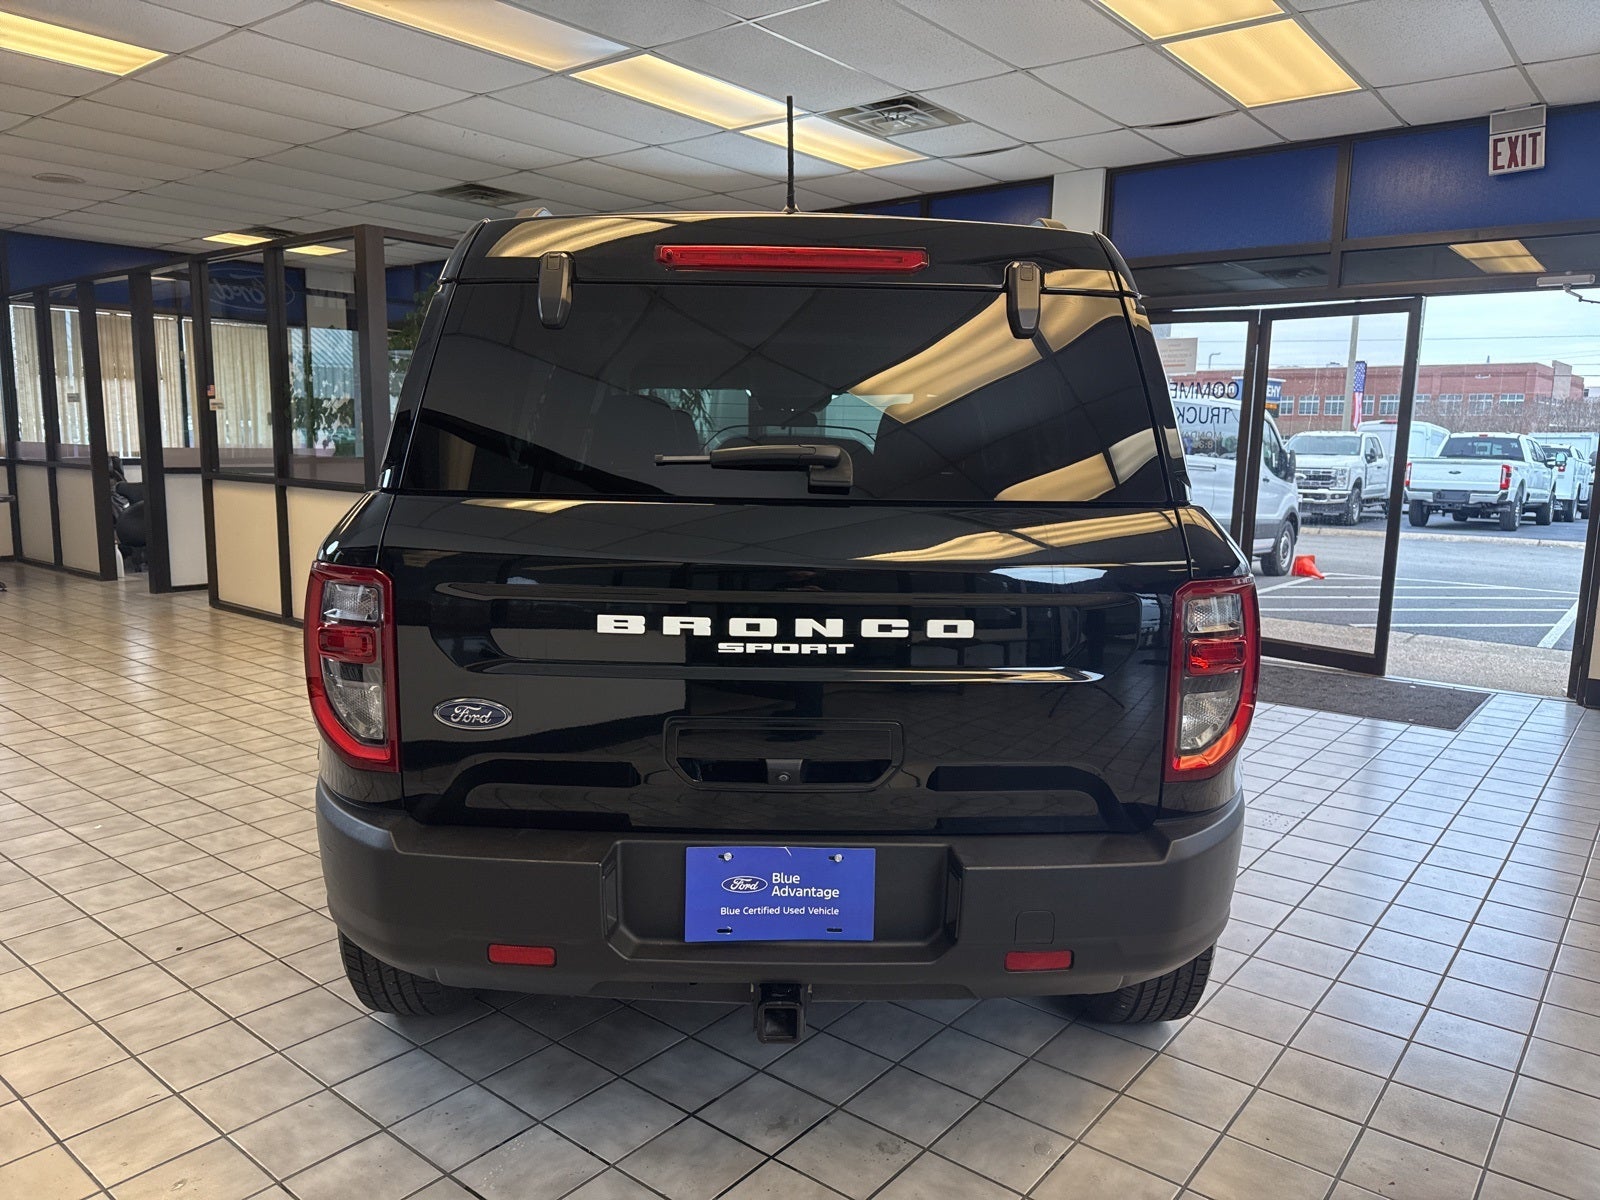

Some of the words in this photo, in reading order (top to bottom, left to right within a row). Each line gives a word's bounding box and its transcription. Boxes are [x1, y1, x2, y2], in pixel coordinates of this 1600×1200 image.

[1492, 131, 1542, 171] EXIT
[596, 614, 975, 639] BRONCO
[717, 642, 855, 655] SPORT
[450, 705, 493, 724] Ford
[730, 877, 759, 891] Ford
[772, 872, 801, 884] Blue
[771, 885, 840, 900] Advantage
[720, 906, 741, 916] Blue
[743, 906, 780, 915] Certified
[783, 906, 805, 915] Used
[807, 906, 840, 916] Vehicle
